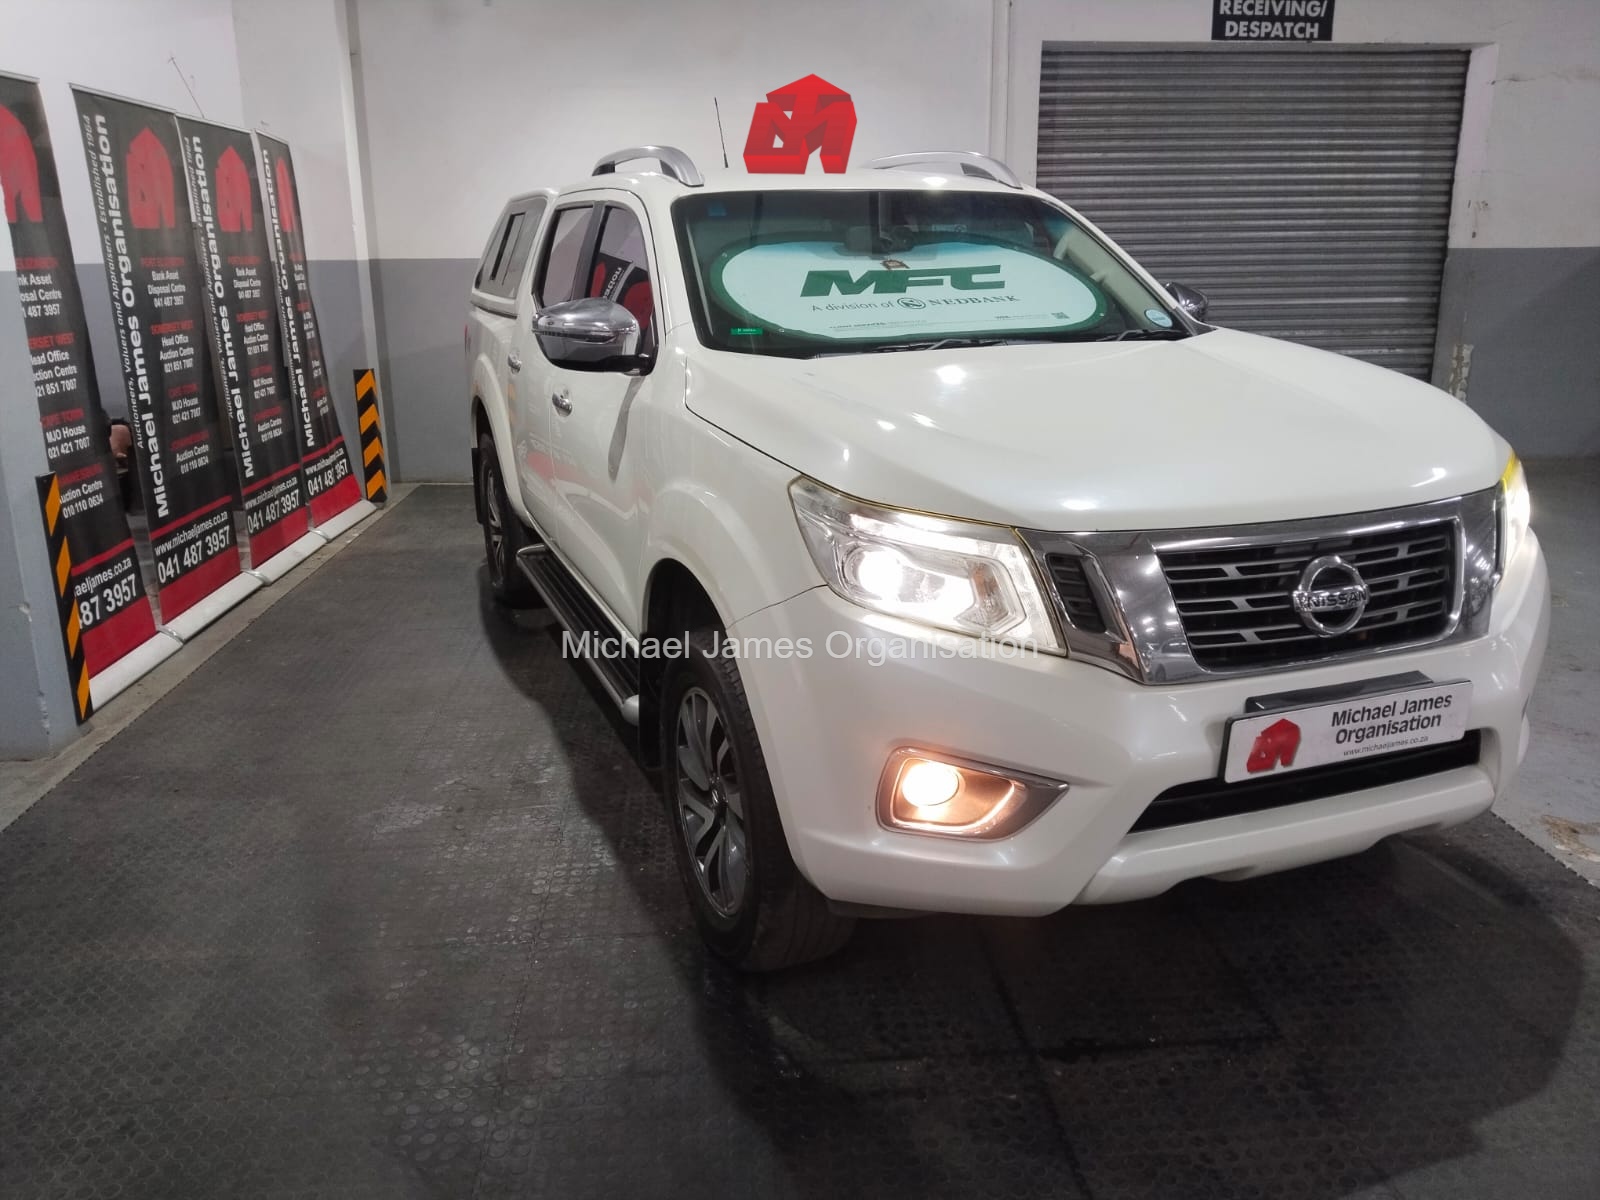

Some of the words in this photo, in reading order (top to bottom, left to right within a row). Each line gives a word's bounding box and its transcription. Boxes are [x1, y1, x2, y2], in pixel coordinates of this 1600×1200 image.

[1219, 0, 1328, 17] RECEIVING/
[1224, 20, 1320, 39] DESPATCH
[95, 114, 135, 308] Organisation
[192, 136, 224, 298] Organisation
[20, 290, 37, 302] osal
[38, 288, 62, 301] Centre
[29, 273, 52, 286] Asset
[800, 265, 1005, 298] MFC
[811, 303, 823, 312] A
[825, 300, 878, 312] division
[880, 300, 895, 309] of
[929, 295, 1021, 306] NEDBANK
[219, 305, 239, 382] James
[285, 296, 301, 363] James
[31, 352, 46, 365] ead
[46, 350, 70, 363] Office
[34, 369, 53, 381] ction
[54, 365, 77, 378] Centre
[128, 315, 151, 405] James
[45, 382, 60, 395] 851
[295, 368, 315, 447] Michael
[62, 424, 87, 438] House
[231, 388, 254, 478] Michael
[47, 446, 60, 459] 021
[60, 441, 74, 455] 421
[141, 412, 169, 518] Michael
[81, 480, 103, 495] Centre
[307, 475, 323, 496] 041
[247, 509, 264, 534] 041
[265, 499, 280, 523] 487
[280, 488, 300, 514] 3957
[154, 511, 229, 557] www.michaeljames.co.za
[158, 554, 180, 584] 041
[183, 540, 203, 568] 487
[205, 525, 230, 556] 3957
[75, 557, 132, 598] aeljames.co.za
[103, 573, 136, 612] 3957
[1331, 702, 1397, 727] Michael
[1399, 694, 1453, 719] James
[1335, 713, 1442, 744] Organisation
